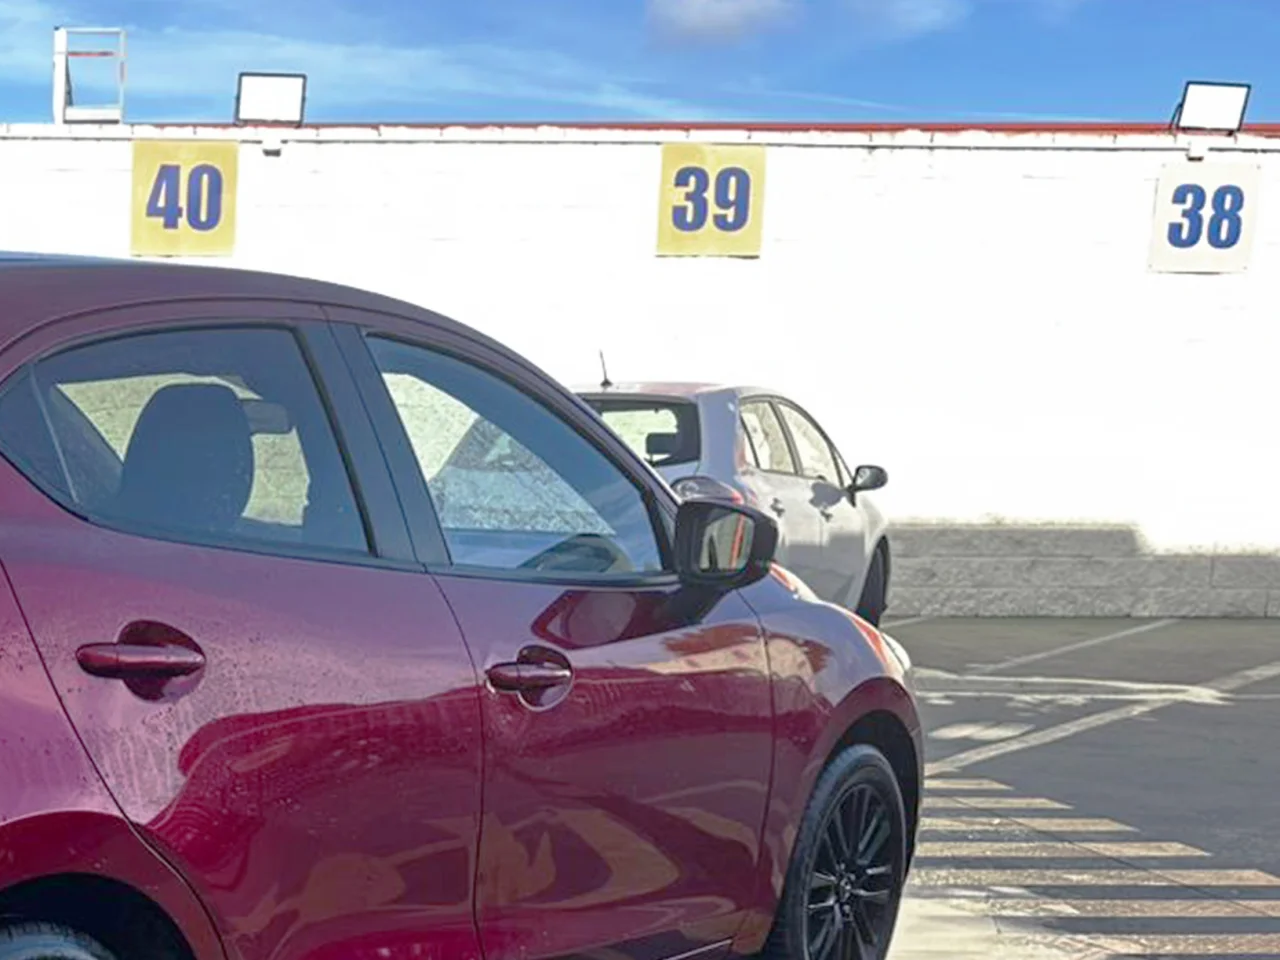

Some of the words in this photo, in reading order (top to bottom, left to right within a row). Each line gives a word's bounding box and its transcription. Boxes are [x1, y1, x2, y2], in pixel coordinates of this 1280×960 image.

[145, 163, 223, 232] 40
[671, 166, 751, 232] 39
[1167, 183, 1245, 249] 38
